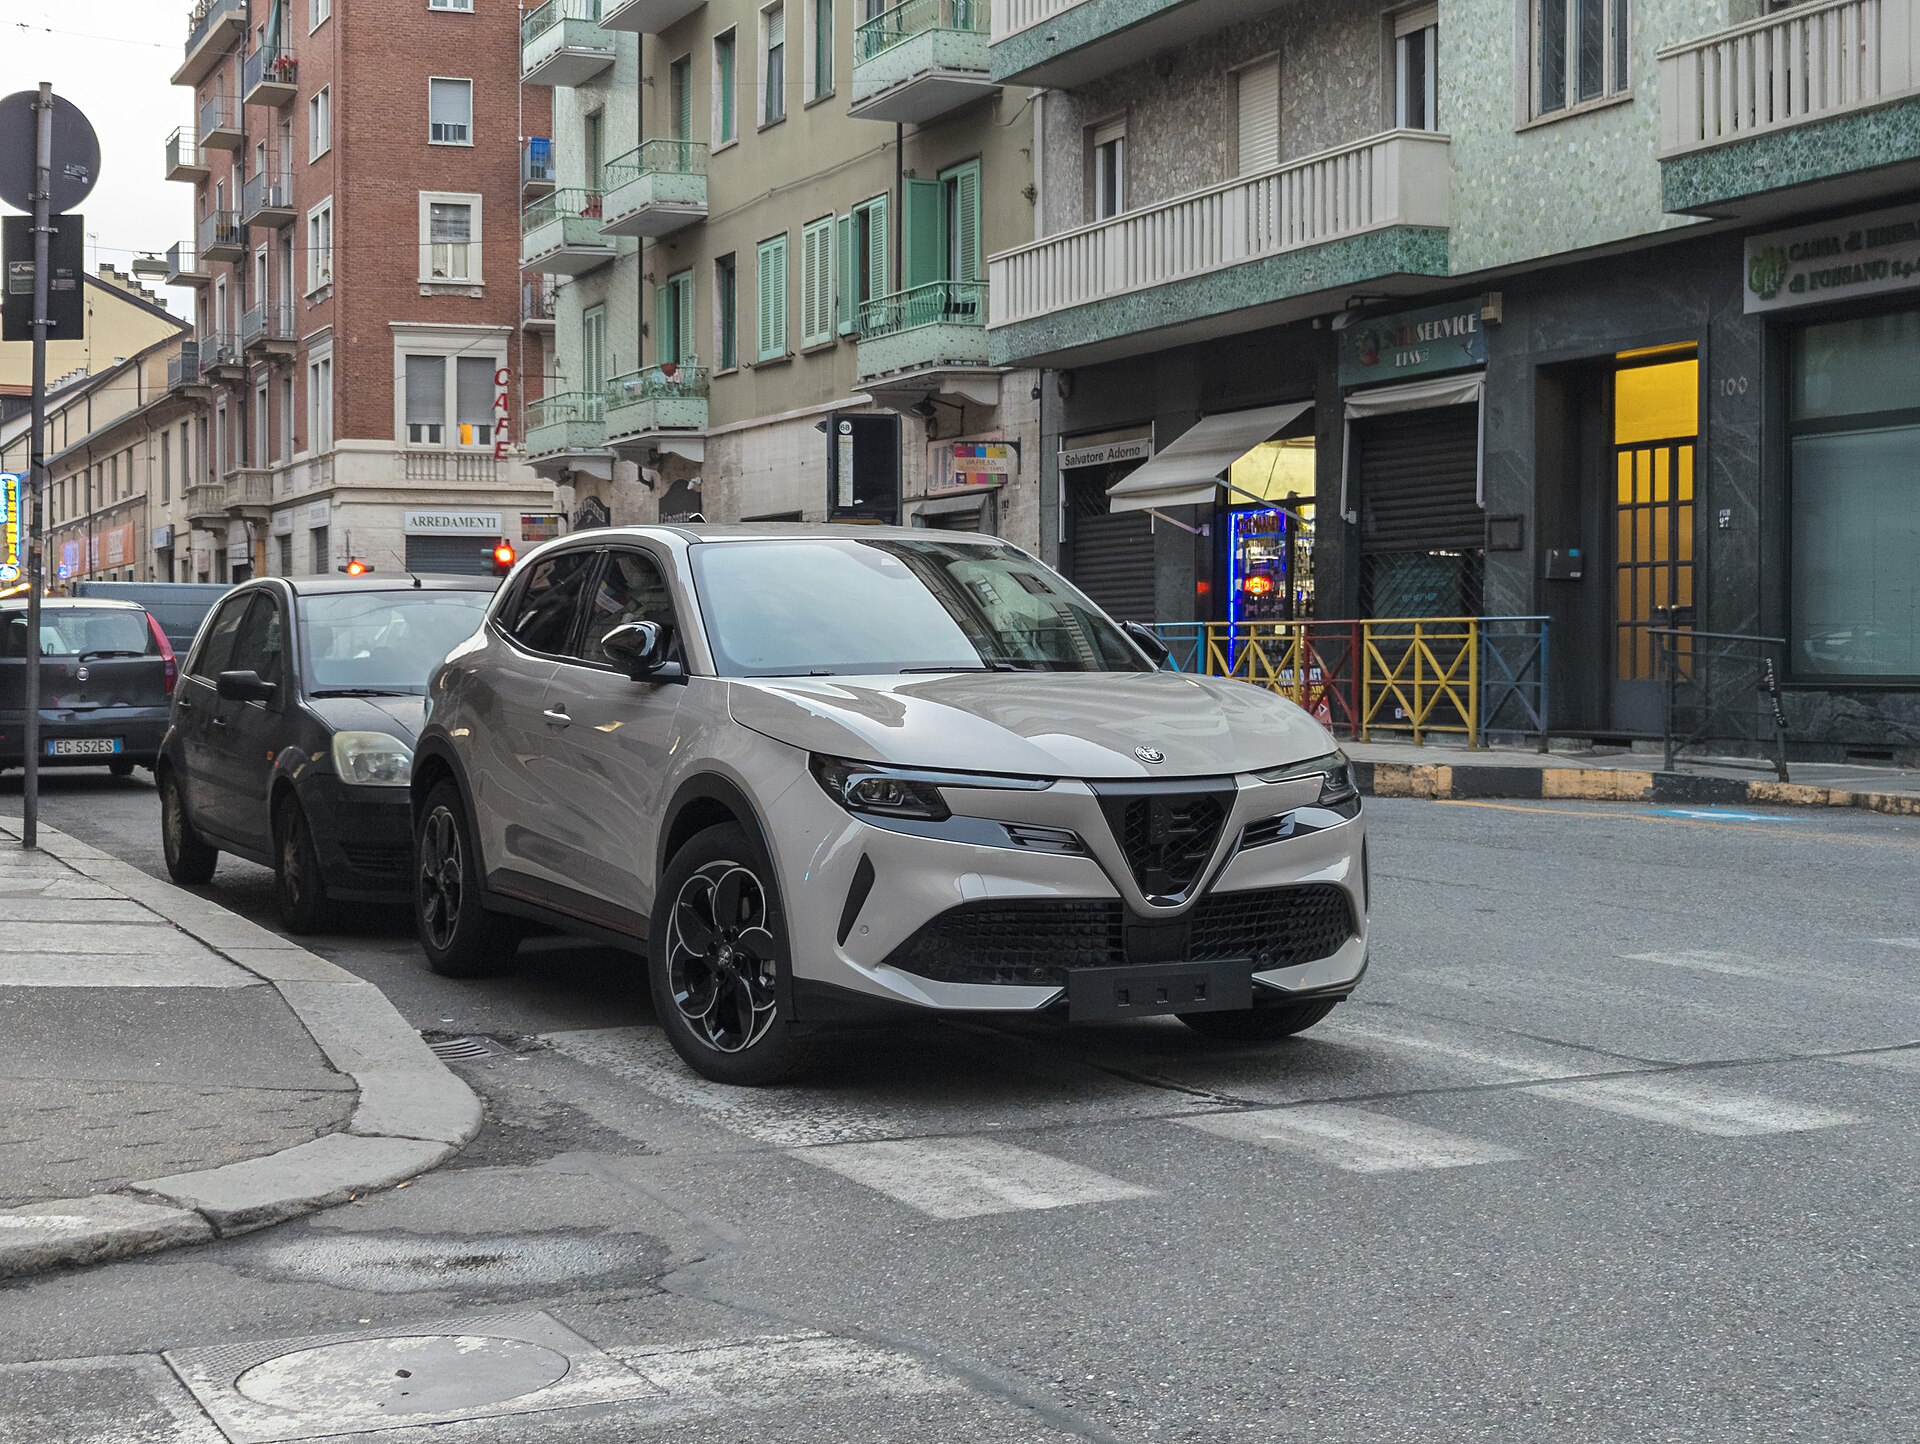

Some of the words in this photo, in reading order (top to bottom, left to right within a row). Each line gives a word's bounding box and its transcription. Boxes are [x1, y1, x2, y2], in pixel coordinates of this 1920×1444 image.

[1416, 313, 1478, 342] SERVICE
[1720, 376, 1747, 397] 100
[491, 367, 512, 461] CAFE
[840, 423, 851, 432] 68
[1064, 452, 1104, 467] Salvatore
[1107, 445, 1141, 460] Adorno
[410, 516, 497, 529] ARREDAMENTI
[56, 741, 72, 754] EG
[75, 740, 113, 753] 552ES
